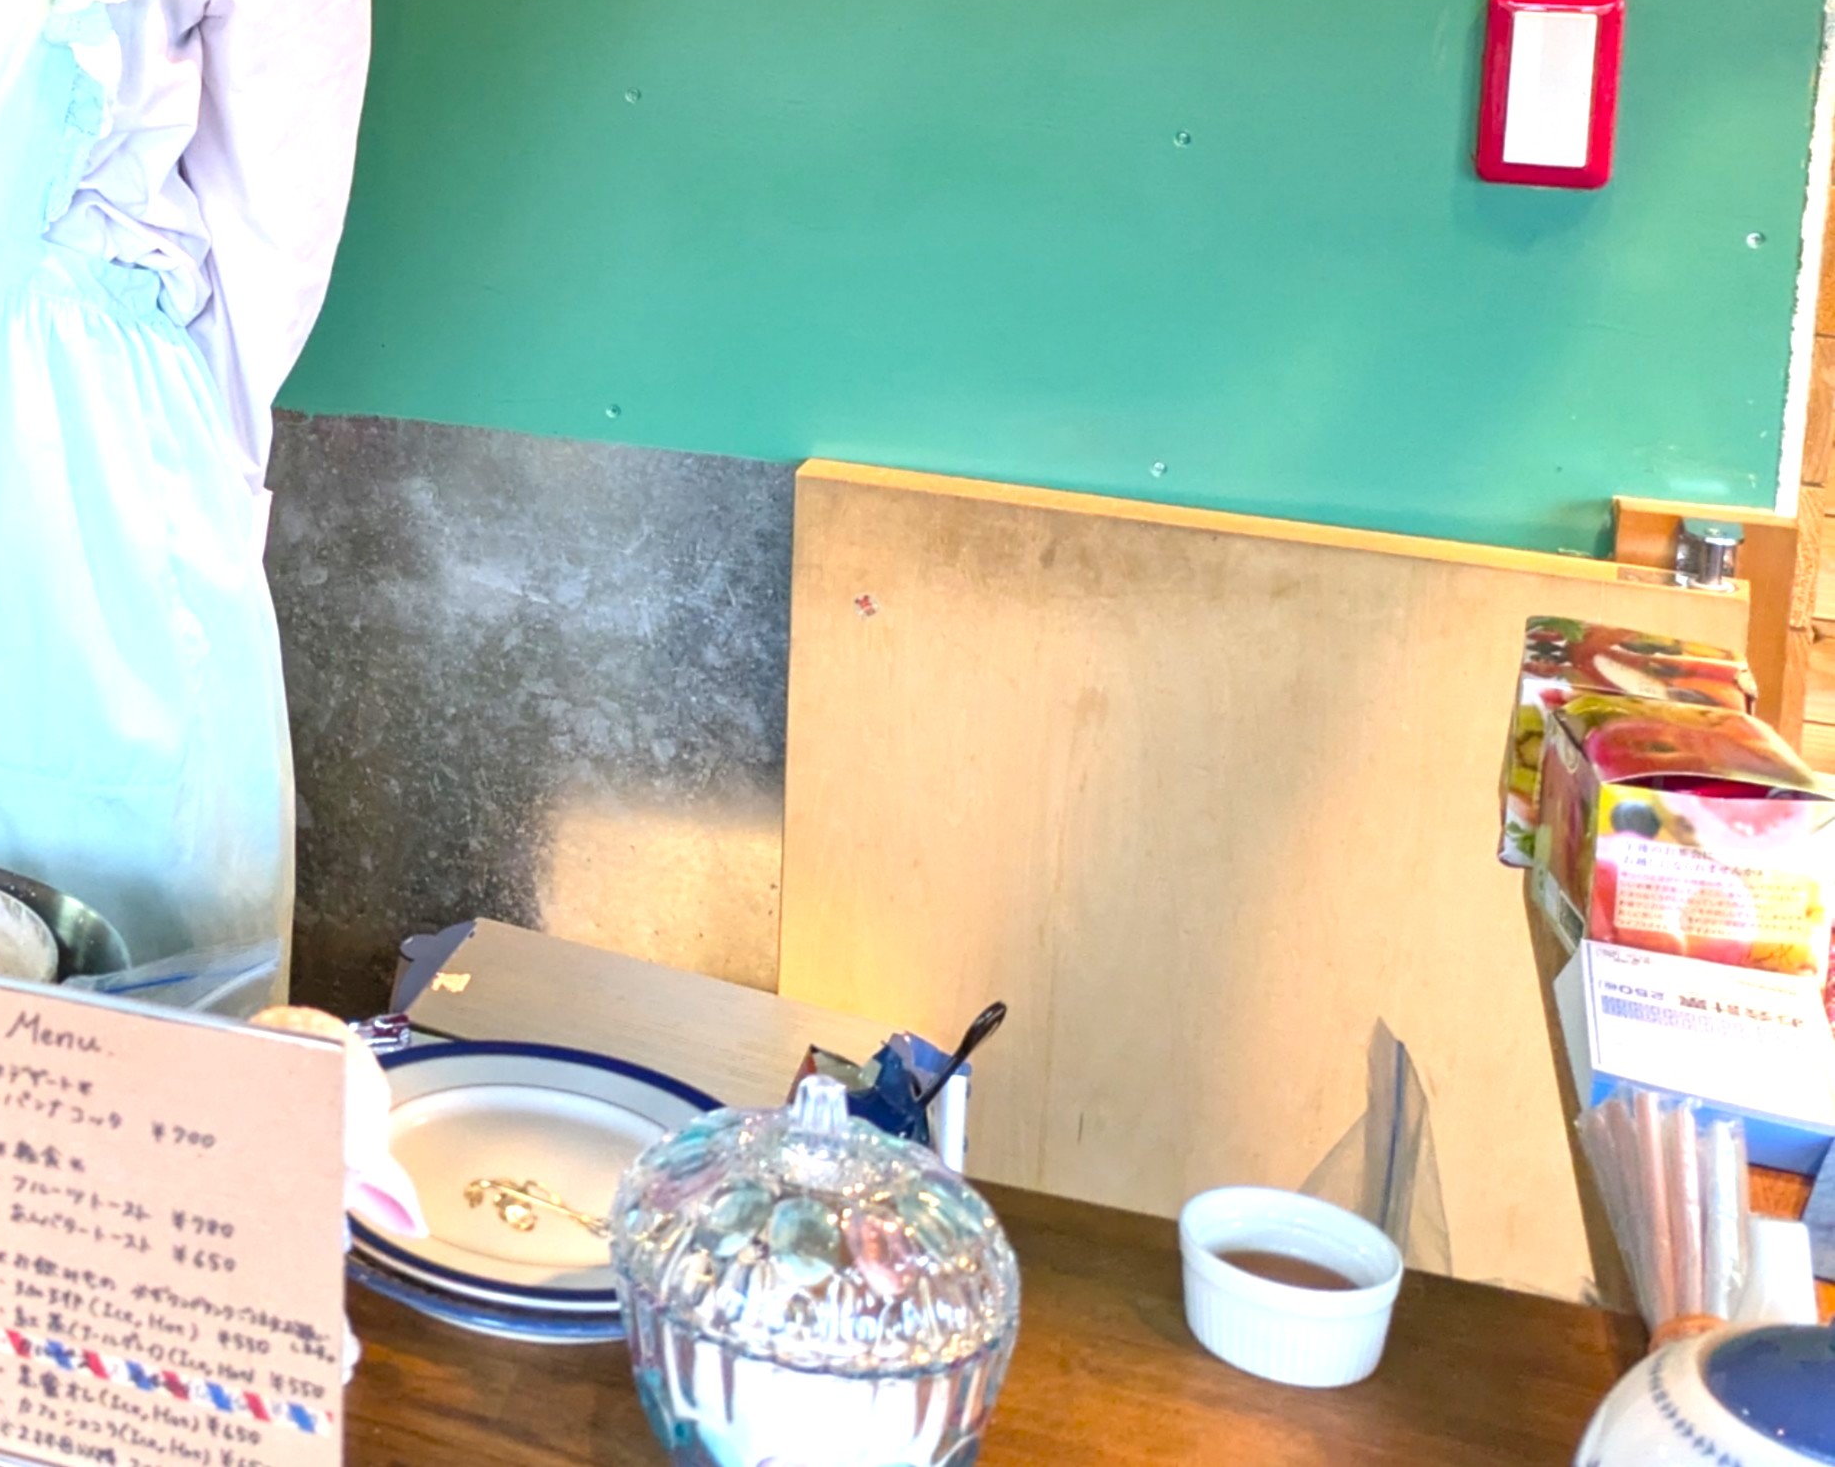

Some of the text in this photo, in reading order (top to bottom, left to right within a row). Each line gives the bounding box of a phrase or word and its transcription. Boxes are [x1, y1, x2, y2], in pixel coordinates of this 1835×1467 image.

[13, 1175, 152, 1222] フルーツトースト
